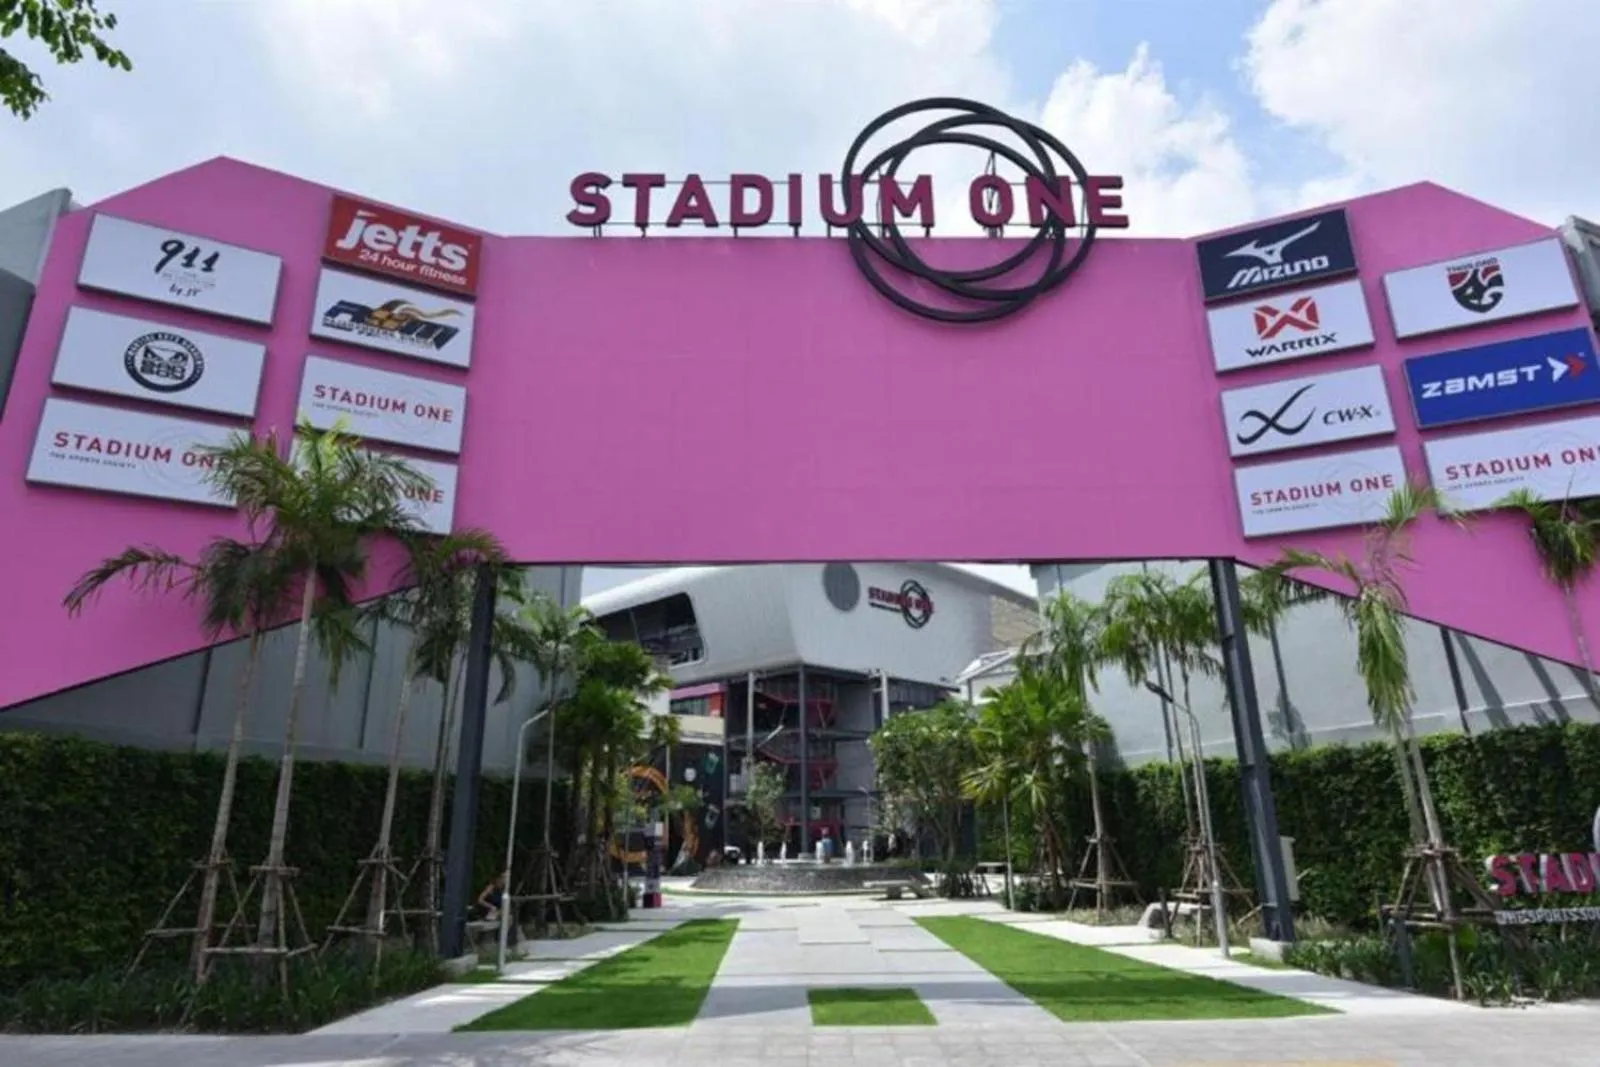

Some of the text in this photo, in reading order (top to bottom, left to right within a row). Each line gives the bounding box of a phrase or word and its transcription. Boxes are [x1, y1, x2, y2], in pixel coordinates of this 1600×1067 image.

[566, 171, 1130, 229] STADIUM ONE
[154, 239, 221, 274] 911
[336, 209, 470, 272] jetts
[358, 248, 468, 288] 24 hour fitness
[1226, 255, 1329, 289] MIZUNO
[1246, 332, 1338, 358] WARRIX
[313, 384, 407, 414] STADIUM
[414, 404, 454, 423] ONE
[1322, 404, 1375, 426] CW-X
[53, 431, 173, 464] STADIUM
[1445, 445, 1600, 481] STADIUM ON
[1250, 474, 1395, 506] STADIUM ONE
